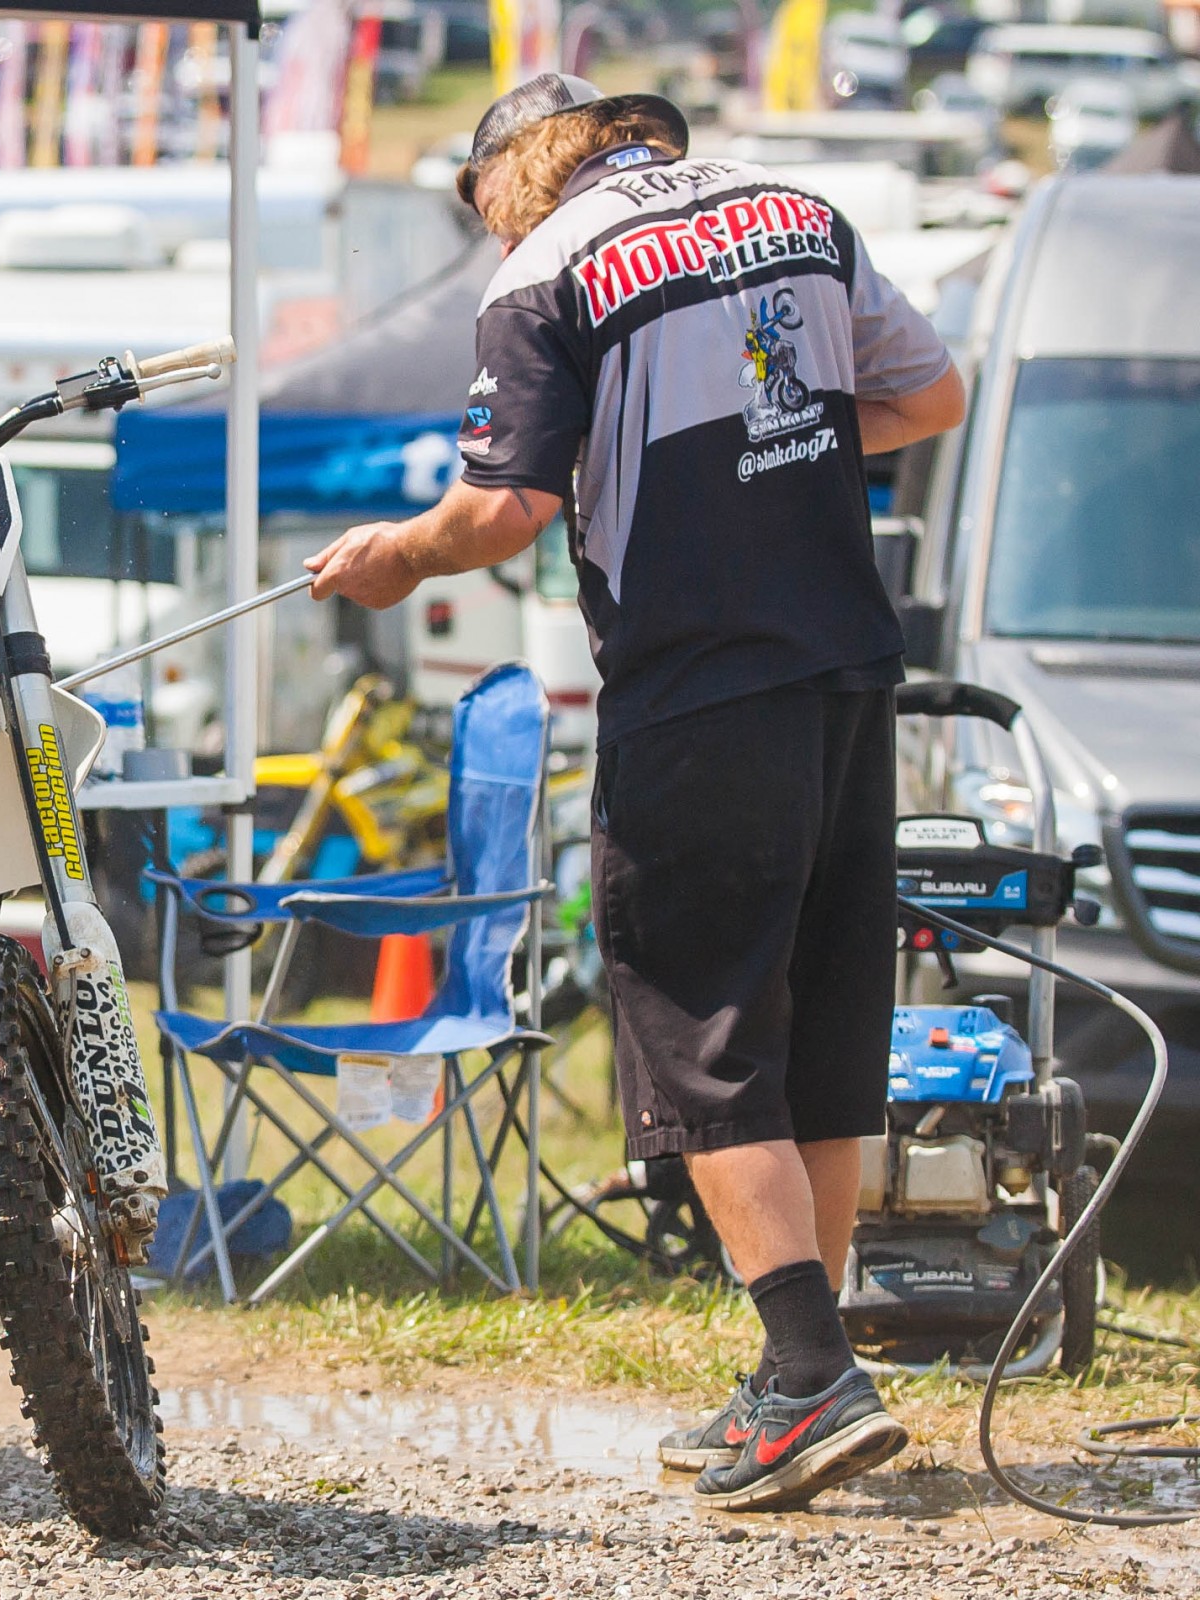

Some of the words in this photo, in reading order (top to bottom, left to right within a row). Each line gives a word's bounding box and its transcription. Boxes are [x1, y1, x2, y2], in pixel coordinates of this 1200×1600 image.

[921, 882, 986, 894] SUBARU
[77, 972, 124, 1143] DUNLO
[902, 1271, 973, 1284] SUBARU
